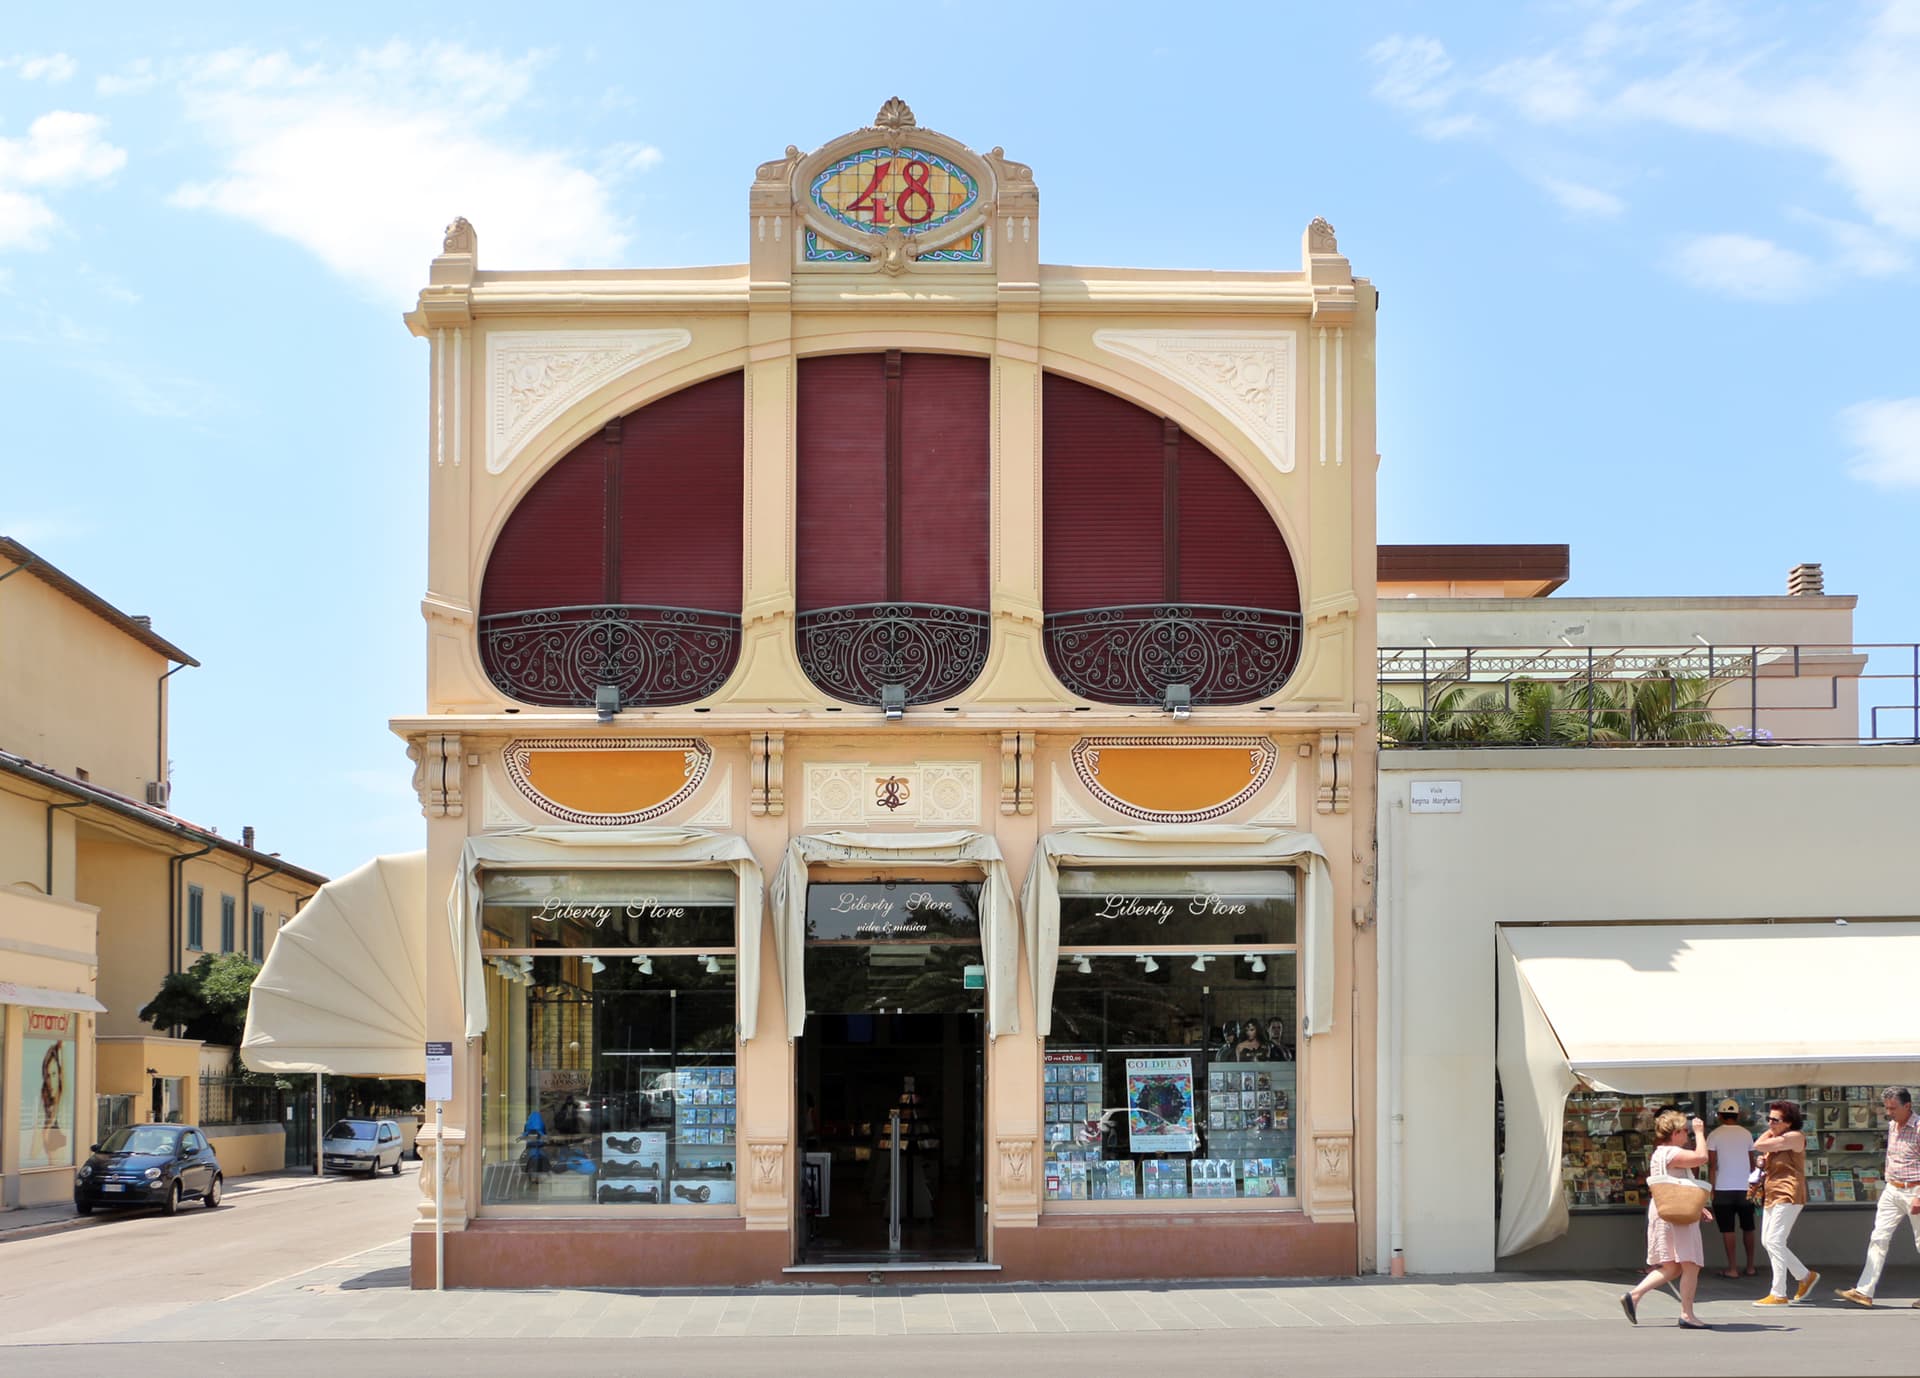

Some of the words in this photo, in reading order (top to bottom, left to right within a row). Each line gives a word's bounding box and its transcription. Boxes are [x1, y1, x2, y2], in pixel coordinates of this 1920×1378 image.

[846, 160, 935, 224] 48
[532, 896, 611, 928] Liberty
[626, 896, 685, 918] Store
[830, 892, 894, 917] Liberty
[905, 892, 953, 911] Store
[1095, 894, 1174, 925] Liberty
[1189, 894, 1246, 915] Store
[857, 921, 881, 932] video
[882, 921, 892, 934] &
[893, 922, 927, 932] musica
[1127, 1060, 1189, 1069] COLDPLAY
